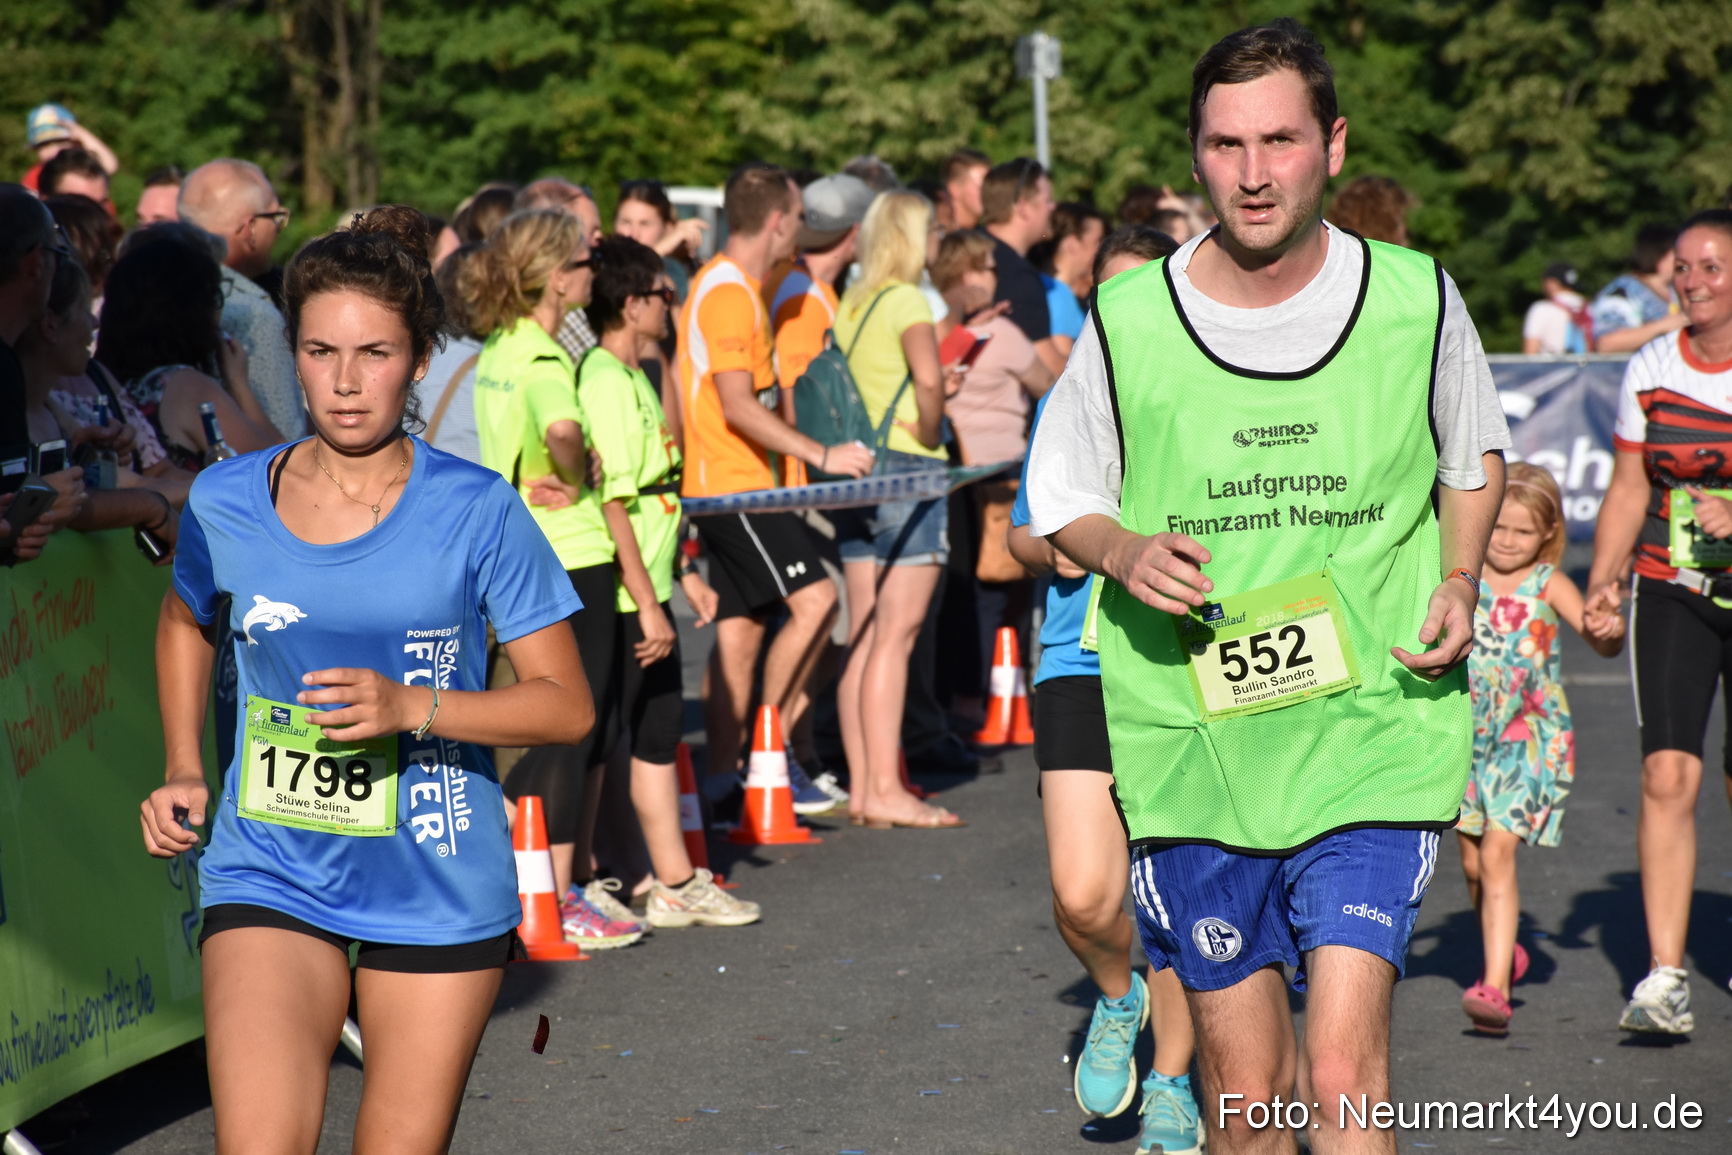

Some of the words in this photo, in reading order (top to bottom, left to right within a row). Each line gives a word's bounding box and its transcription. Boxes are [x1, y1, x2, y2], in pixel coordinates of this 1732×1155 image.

[1207, 473, 1347, 499] Laufgruppe
[1167, 508, 1281, 535] Finanzamt
[1289, 503, 1385, 528] Neumarkt
[407, 628, 451, 638] POWERED
[452, 625, 460, 636] BY
[1256, 611, 1285, 627] 2018
[1218, 624, 1314, 683] 552
[1232, 680, 1268, 696] Bullin
[1271, 668, 1315, 686] Sandro
[1234, 690, 1277, 705] Finanzamt
[1278, 679, 1318, 695] Neumarkt
[262, 718, 309, 738] firmenlauf
[260, 745, 373, 802] 1798
[266, 804, 329, 821] Schwimmschule
[331, 814, 360, 825] Flipper
[275, 793, 310, 808] Stüwe
[314, 800, 350, 814] Selina
[1342, 902, 1393, 928] adidas
[1213, 943, 1226, 955] 04
